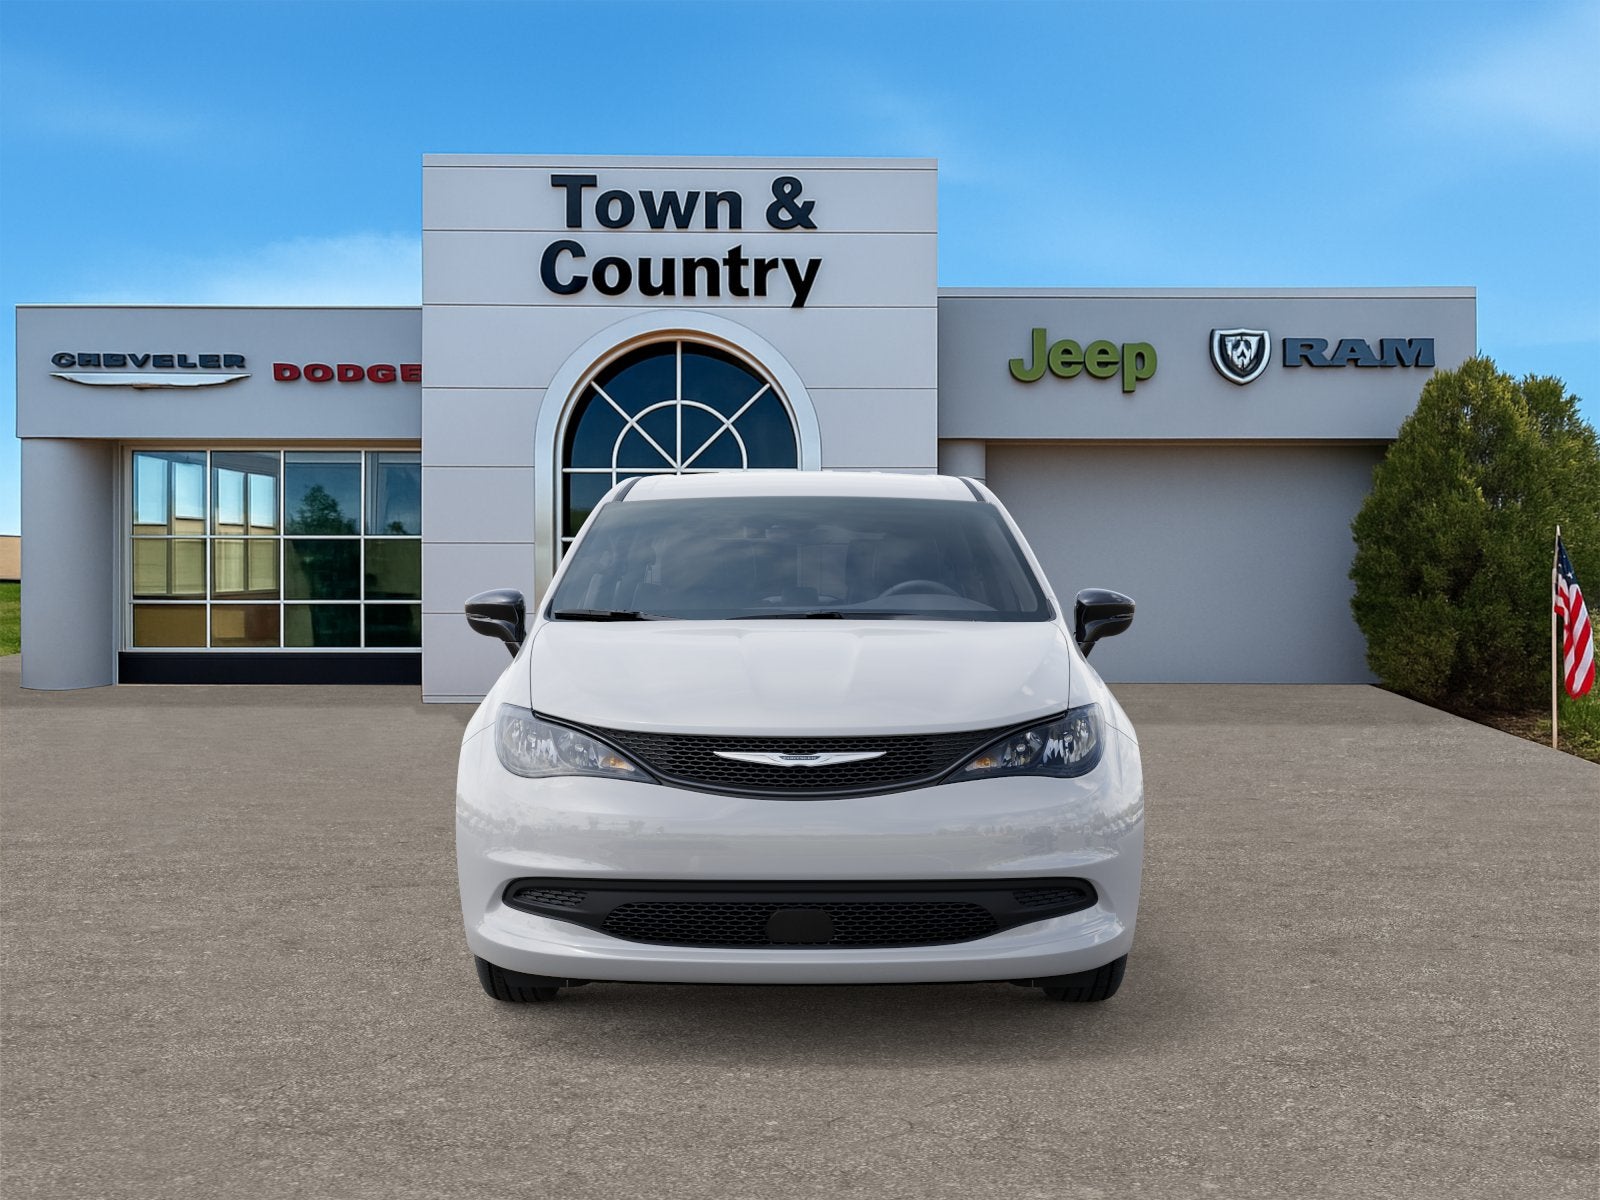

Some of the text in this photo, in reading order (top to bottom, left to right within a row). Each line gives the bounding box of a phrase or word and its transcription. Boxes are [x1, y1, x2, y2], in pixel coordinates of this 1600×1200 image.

[551, 174, 818, 230] Town &
[540, 239, 822, 308] Country
[273, 362, 421, 383] DODGE
[1009, 328, 1157, 393] Jeep
[1283, 337, 1435, 368] RAM
